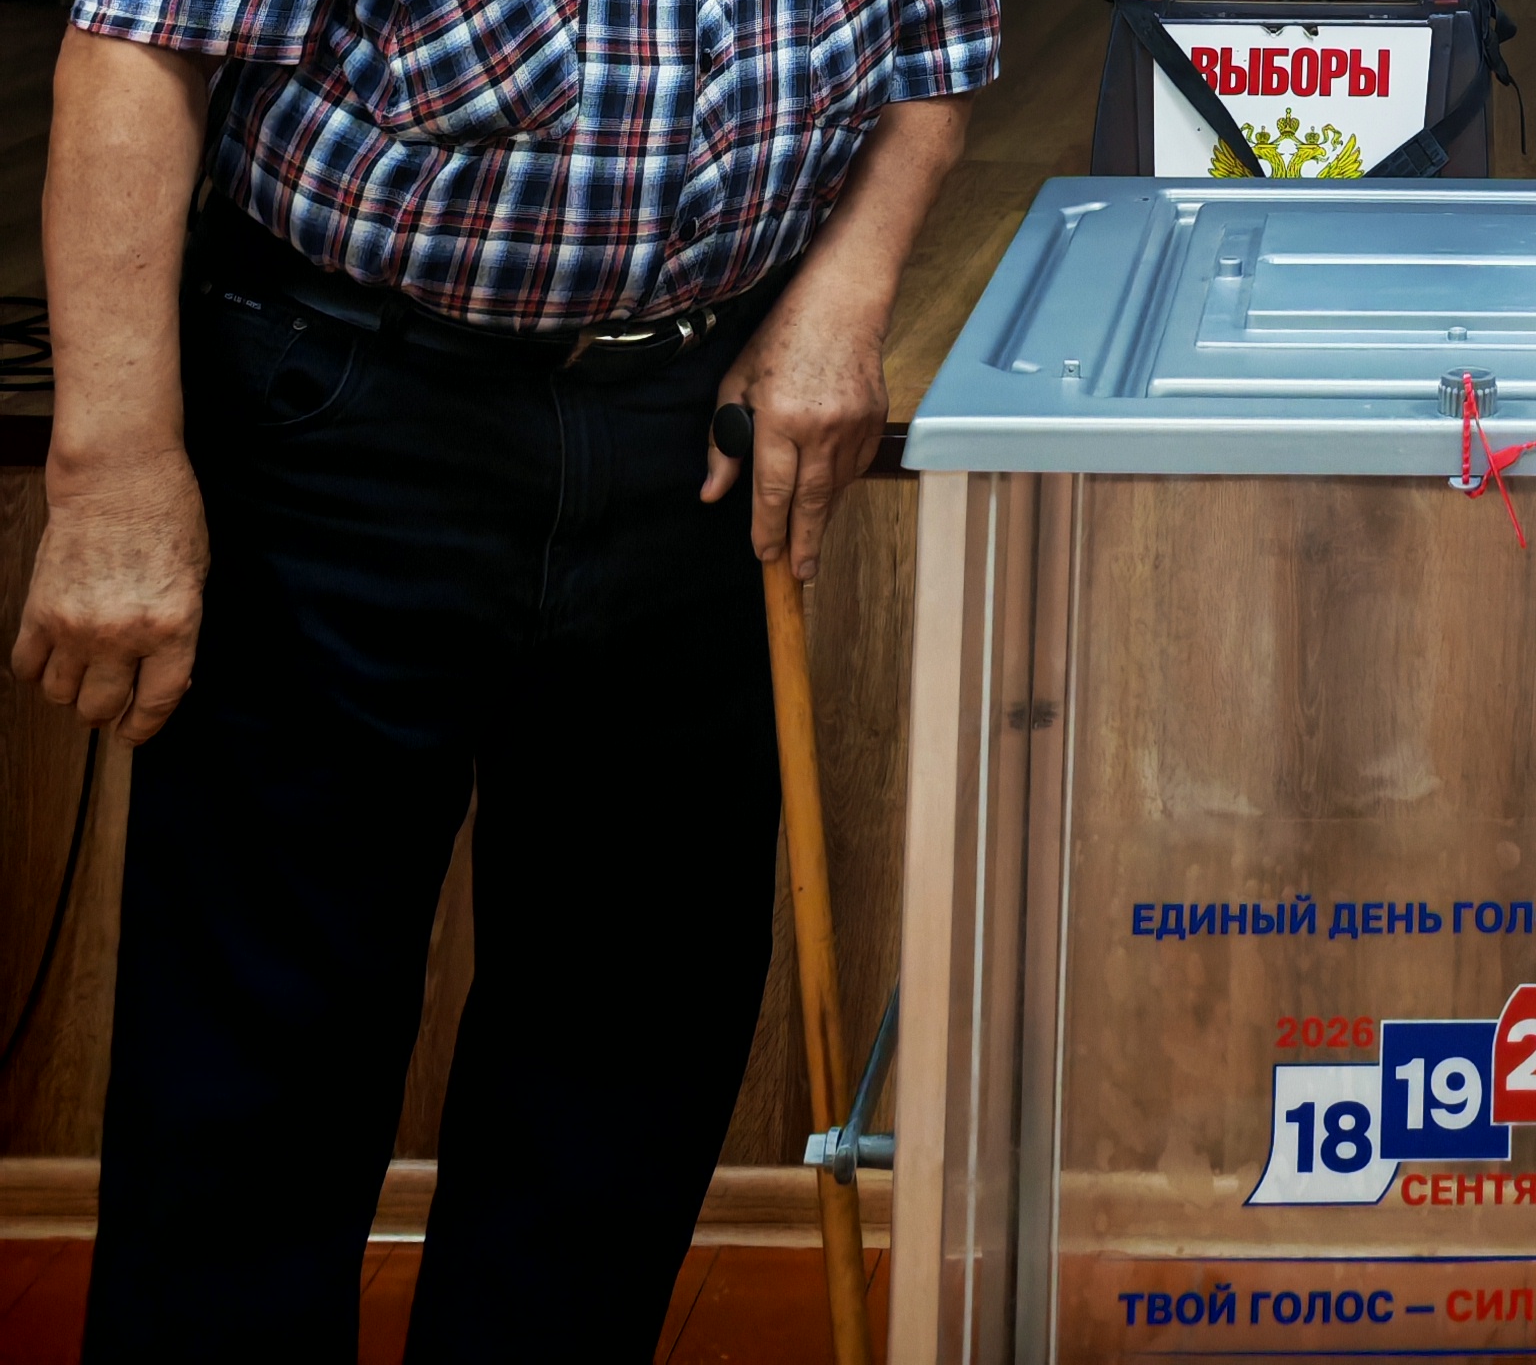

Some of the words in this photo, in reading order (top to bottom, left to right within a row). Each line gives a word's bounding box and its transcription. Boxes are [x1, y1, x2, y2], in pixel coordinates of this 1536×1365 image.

[1190, 46, 1391, 98] ВЫБОРЫ
[1131, 895, 1317, 940] ЕДИНЫЙ
[1328, 902, 1443, 939] ДЕНЬ
[1275, 1015, 1375, 1049] 2026
[1285, 1101, 1374, 1174] 18
[1395, 1057, 1483, 1130] 19
[1118, 1283, 1237, 1326] ТВОЙ
[1250, 1290, 1394, 1325] ГОЛОС
